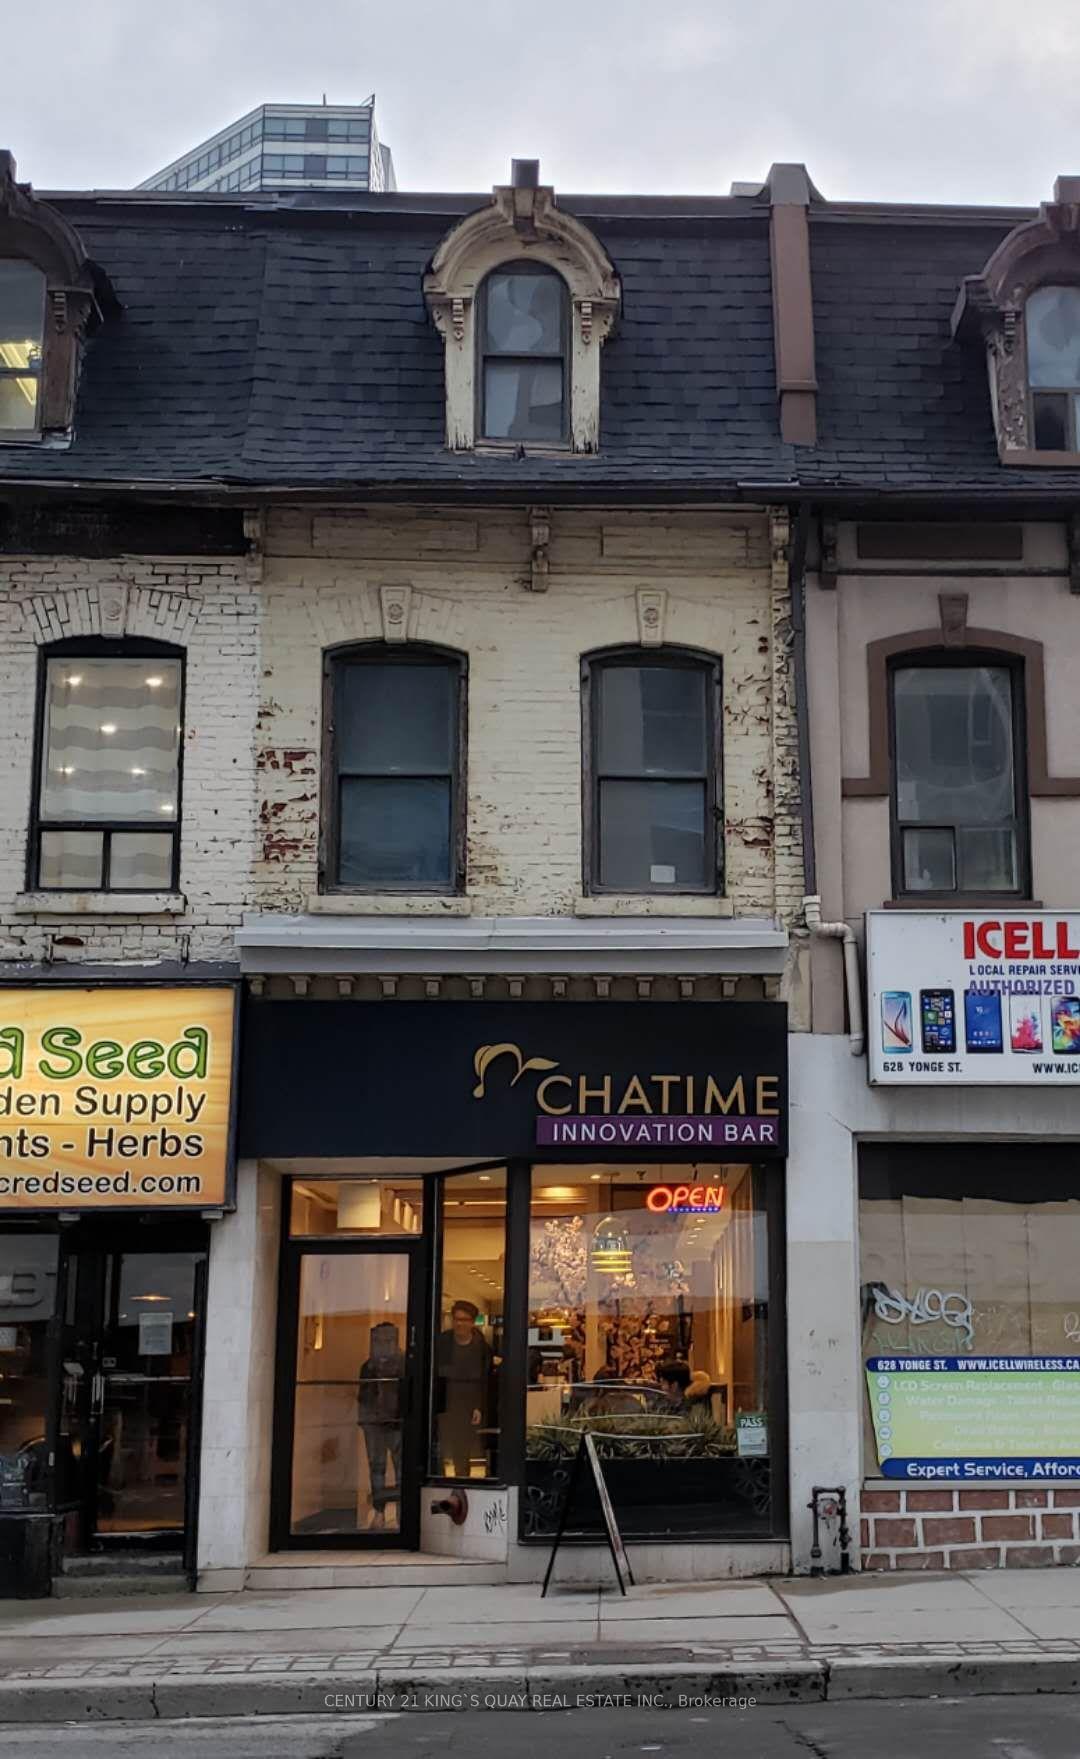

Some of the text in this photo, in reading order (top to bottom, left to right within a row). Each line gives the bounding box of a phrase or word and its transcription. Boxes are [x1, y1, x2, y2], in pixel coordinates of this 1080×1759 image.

[963, 921, 1080, 959] ICELL
[1008, 964, 1047, 975] REPAIR
[969, 980, 1076, 996] AUTHORIZED
[38, 1027, 209, 1080] Seed
[909, 1061, 945, 1072] YONGE
[947, 1061, 963, 1072] ST.
[1032, 1062, 1080, 1074] WWW.IC
[536, 1075, 780, 1115] CHATIME
[75, 1086, 206, 1123] Supply
[553, 1123, 775, 1142] INNOVATION BAR
[88, 1127, 203, 1158] Herbs
[647, 1184, 725, 1213] OPEN
[877, 1359, 1080, 1371] 628 YONGE ST. WWW.ICELLWIRELESS.CA
[740, 1415, 763, 1427] PASS
[907, 1463, 960, 1479] Expert
[964, 1463, 1027, 1479] Service,
